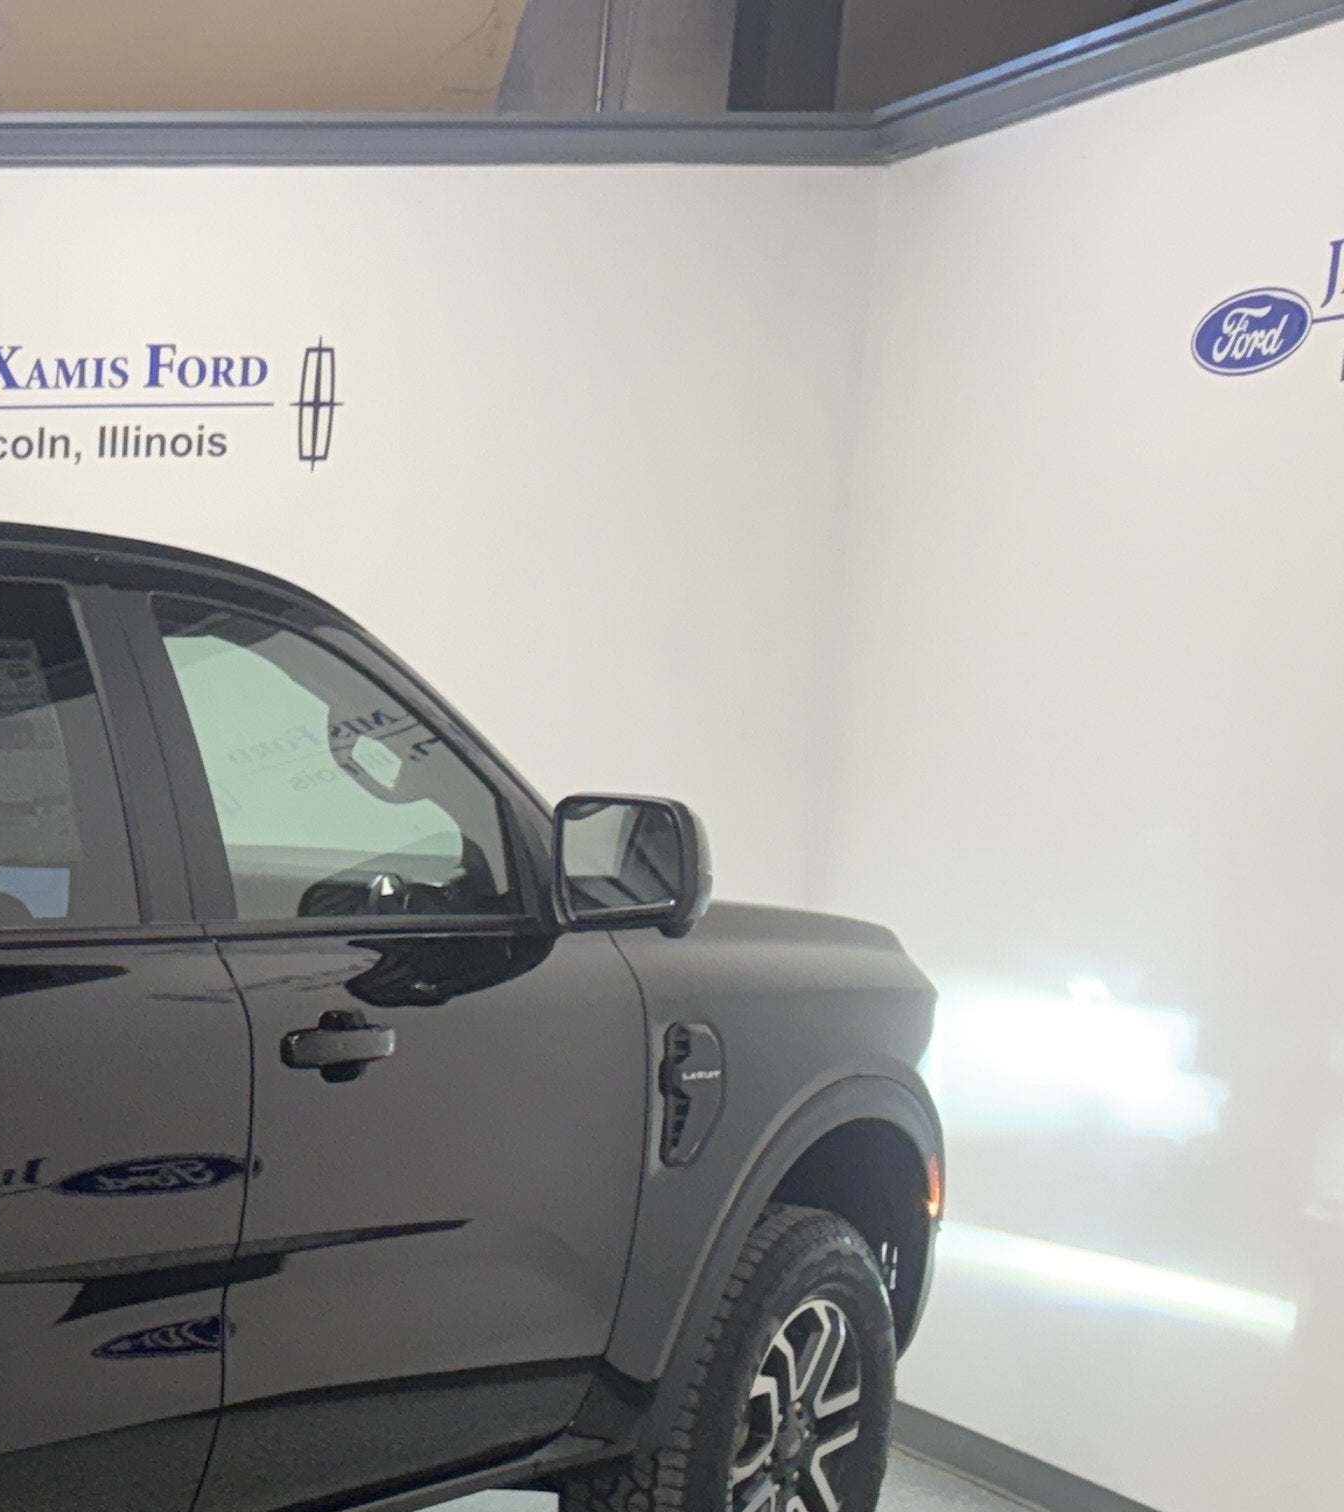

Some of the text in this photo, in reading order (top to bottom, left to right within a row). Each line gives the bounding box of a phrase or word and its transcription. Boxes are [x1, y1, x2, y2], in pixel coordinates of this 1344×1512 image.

[1212, 303, 1291, 363] Ford
[143, 343, 269, 389] FORD
[96, 422, 229, 459] Illinois
